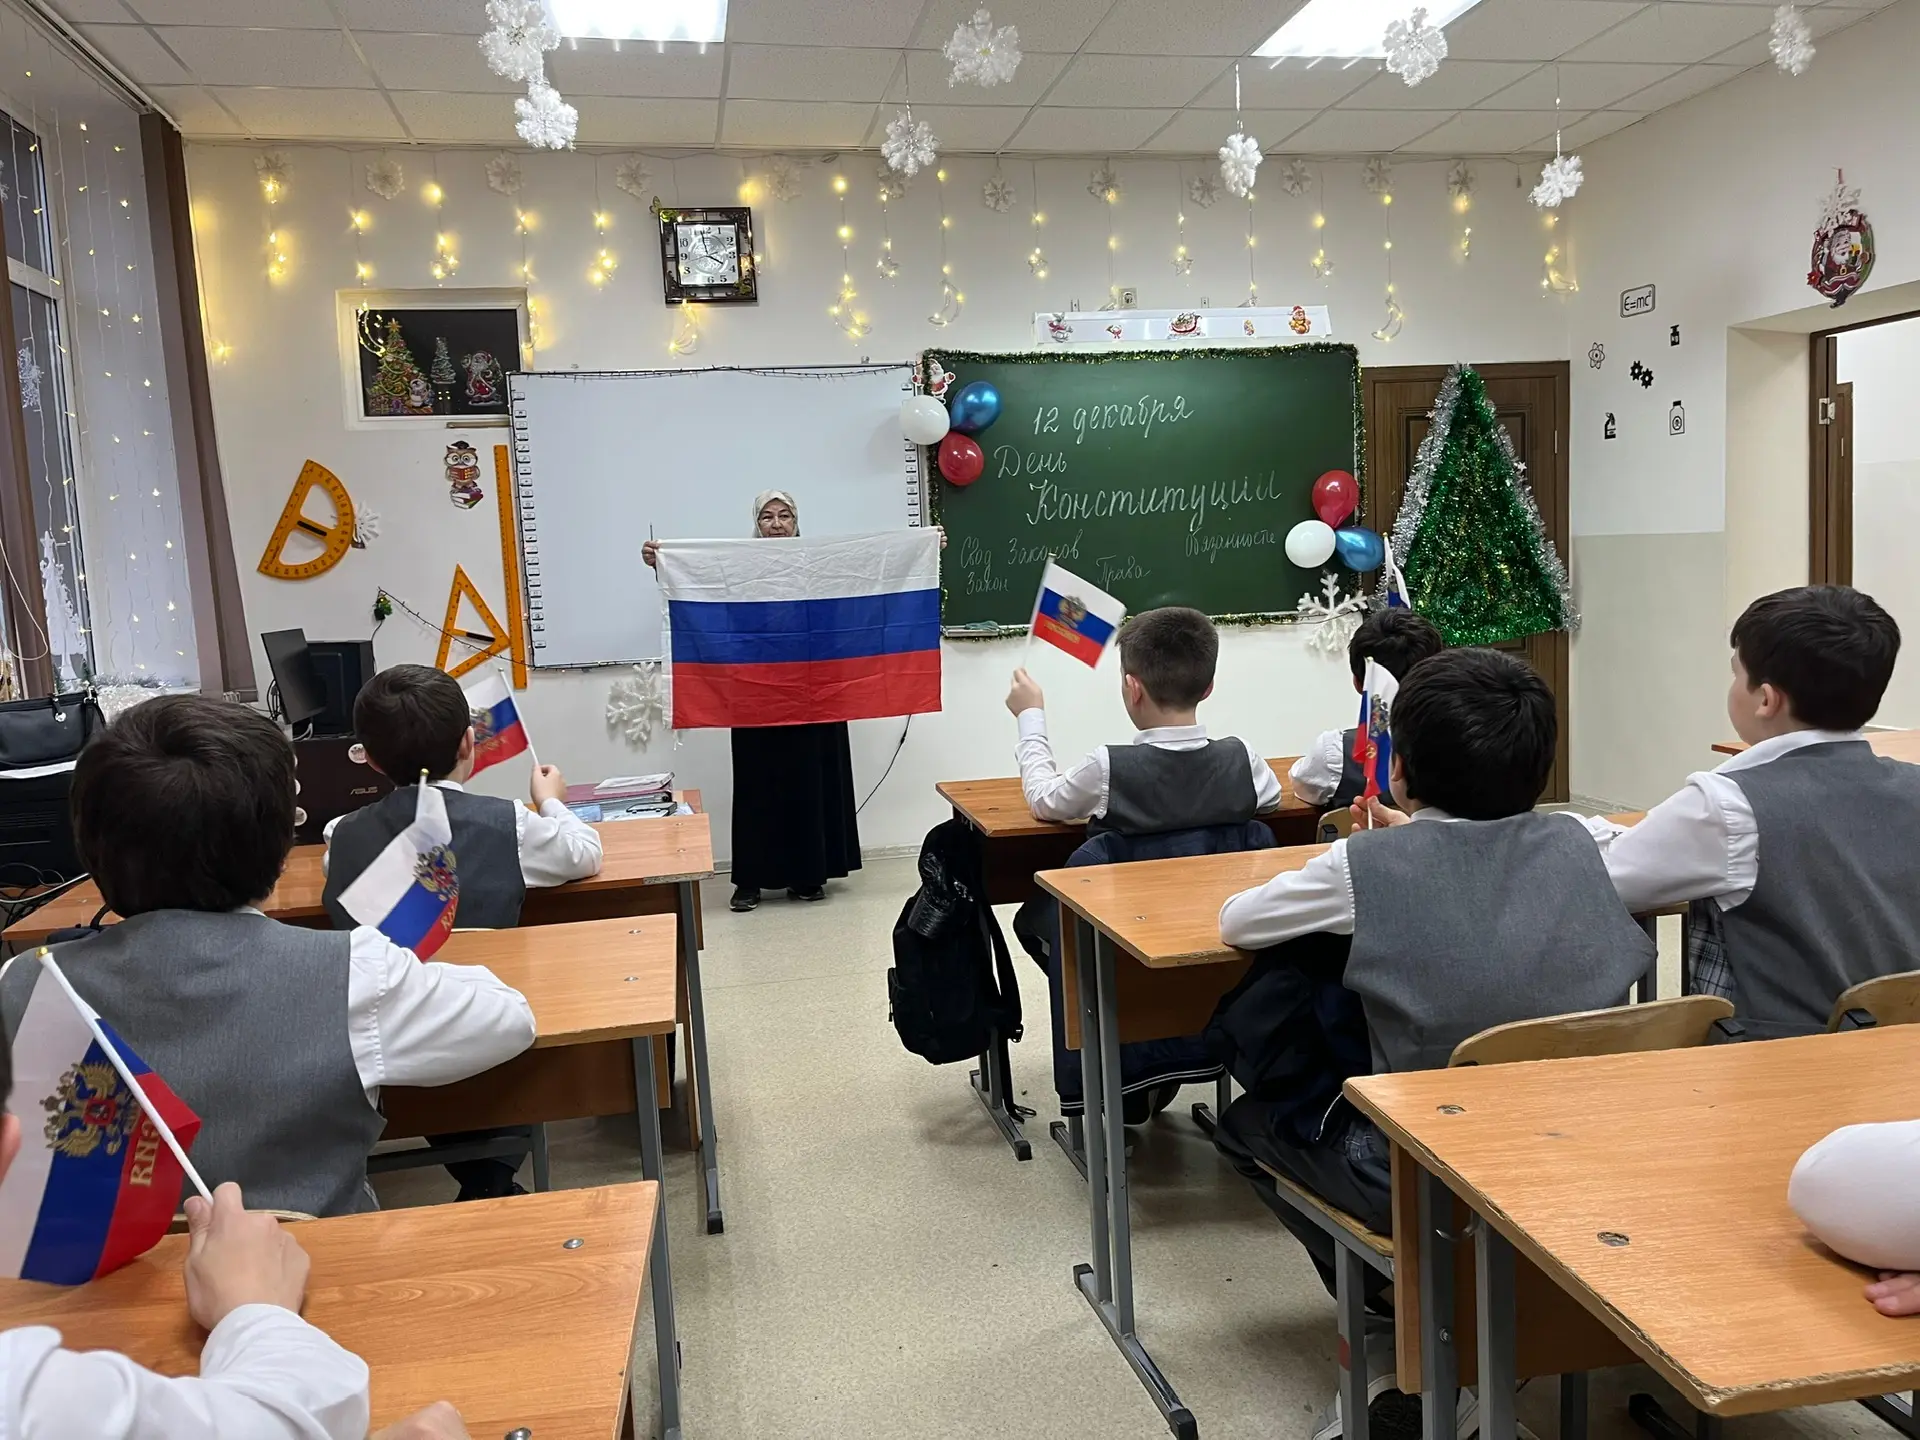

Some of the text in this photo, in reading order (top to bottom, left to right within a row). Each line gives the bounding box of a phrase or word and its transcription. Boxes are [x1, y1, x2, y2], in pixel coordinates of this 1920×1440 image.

[717, 227, 721, 235] 1
[679, 237, 689, 248] 10
[726, 236, 734, 246] 2
[729, 251, 736, 259] 3
[683, 266, 691, 275] 8
[729, 265, 736, 273] 4
[720, 274, 727, 282] 5
[1033, 394, 1195, 445] 12 декабря
[994, 444, 1068, 479] День
[1026, 469, 1282, 532] Конституции
[1095, 554, 1151, 592] Права
[966, 571, 1009, 595] Закон
[350, 786, 378, 795] ASUS
